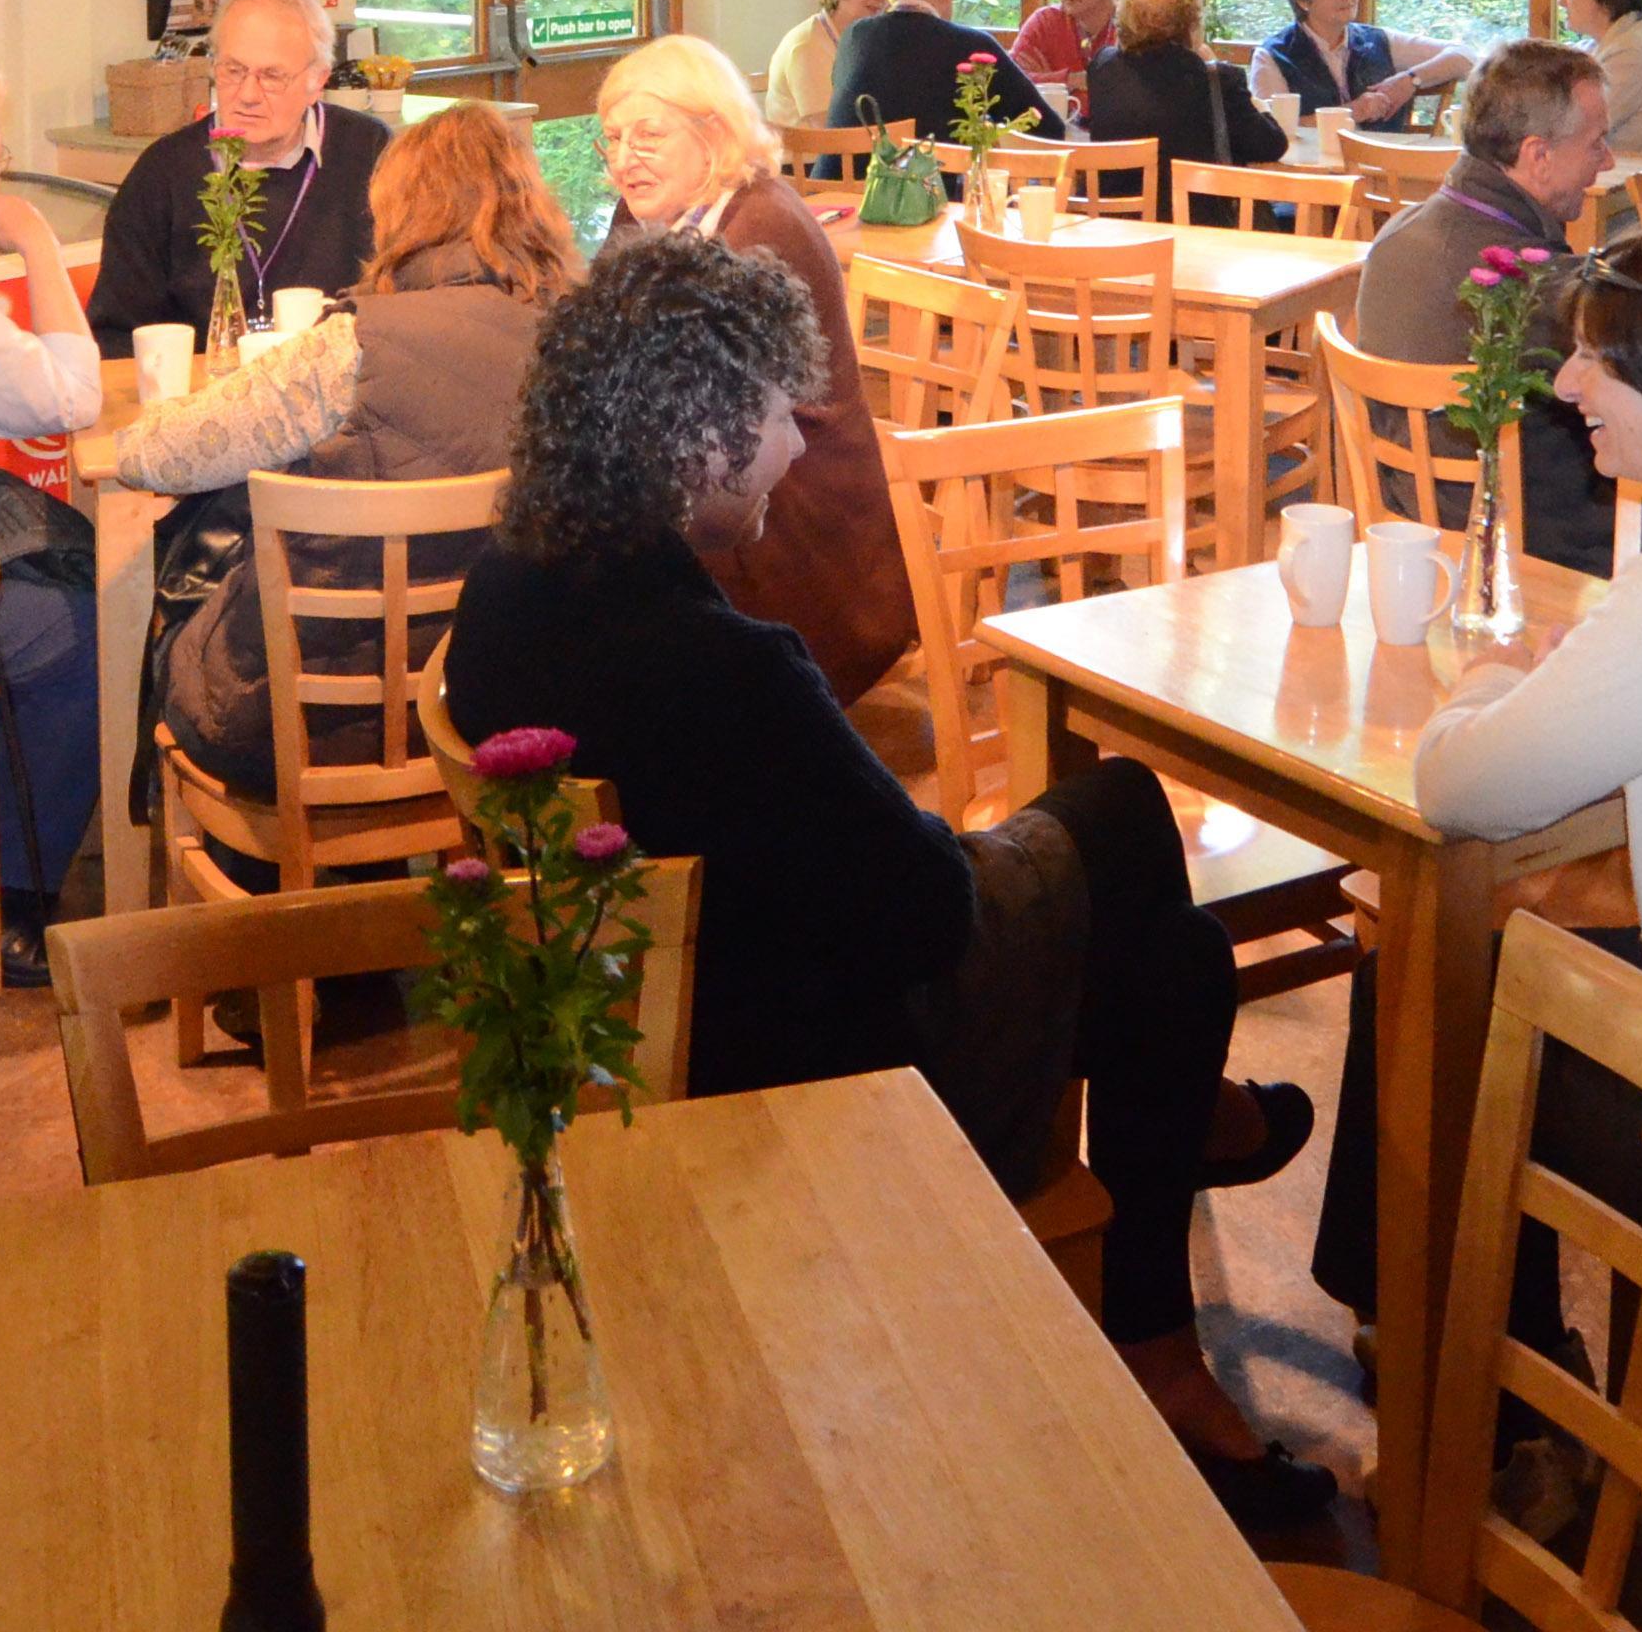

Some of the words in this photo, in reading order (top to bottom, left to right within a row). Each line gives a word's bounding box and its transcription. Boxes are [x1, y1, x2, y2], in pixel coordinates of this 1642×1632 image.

[549, 21, 577, 37] Push
[578, 18, 595, 33] bar
[596, 18, 607, 32] to
[608, 17, 632, 34] open
